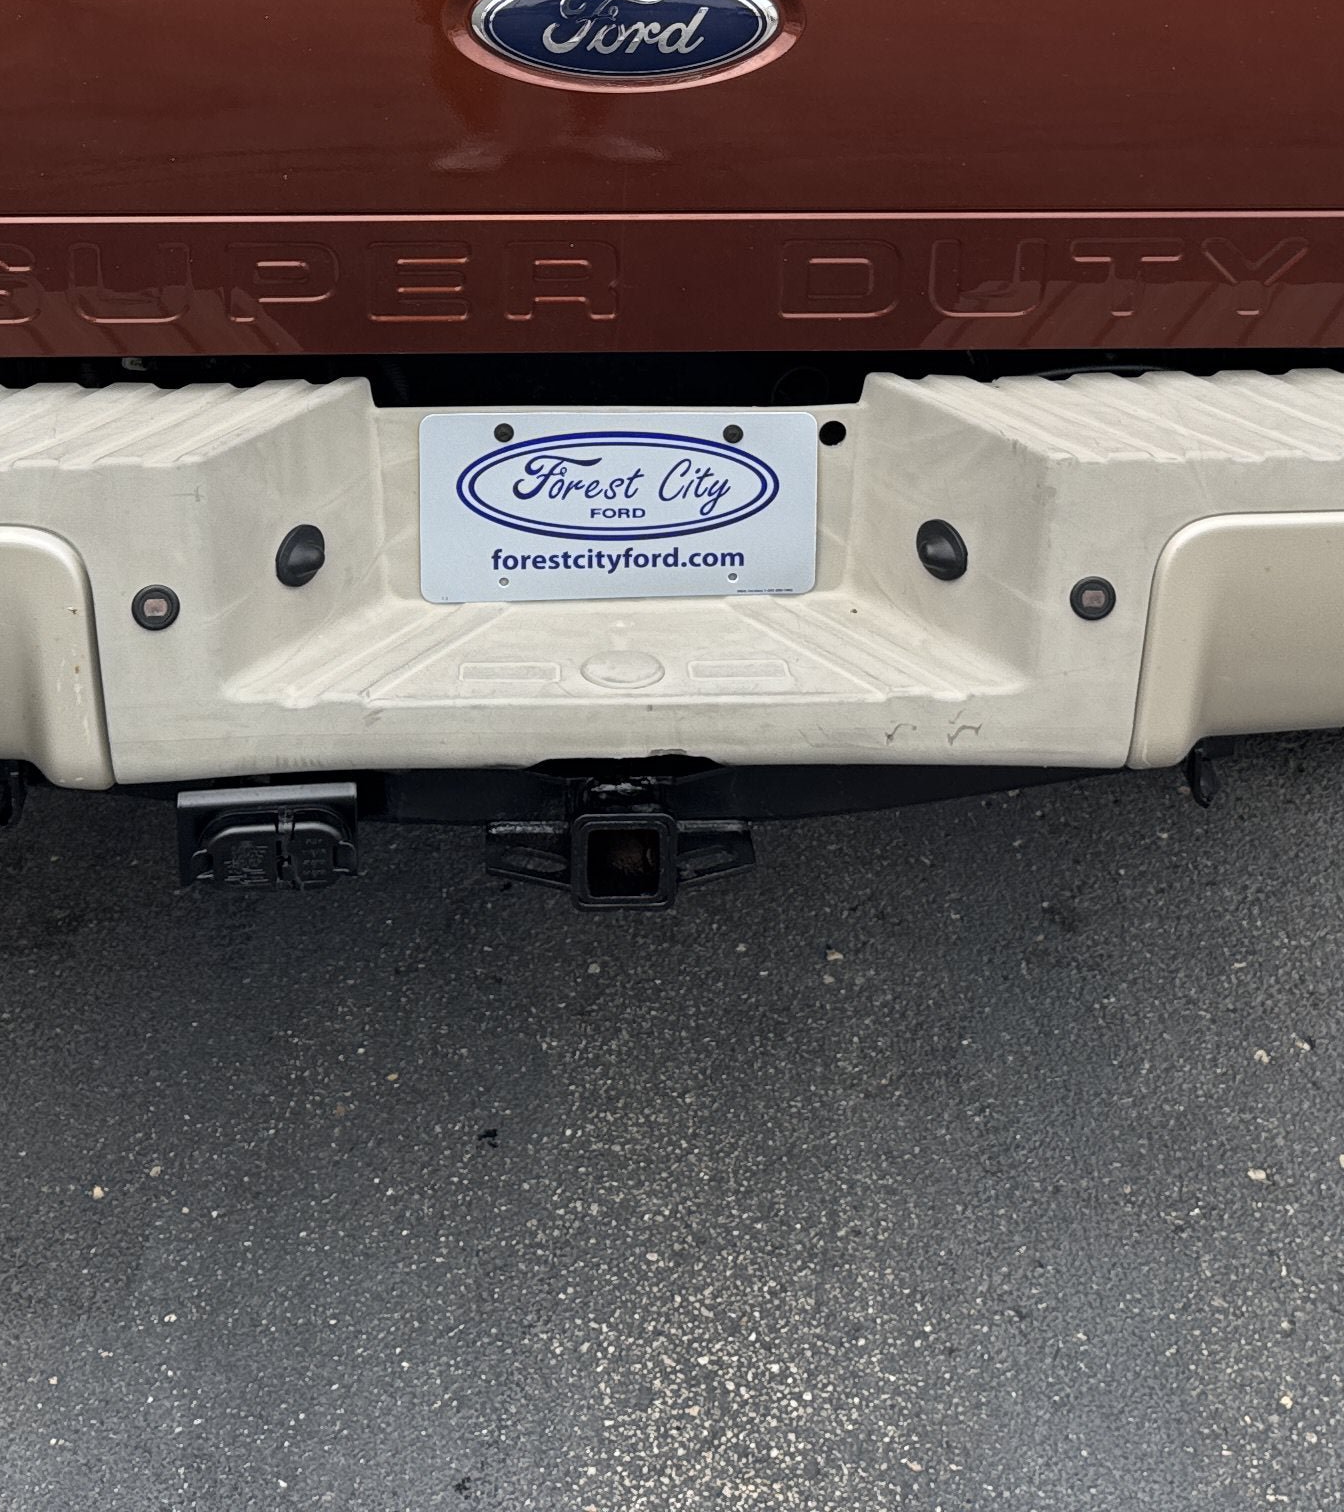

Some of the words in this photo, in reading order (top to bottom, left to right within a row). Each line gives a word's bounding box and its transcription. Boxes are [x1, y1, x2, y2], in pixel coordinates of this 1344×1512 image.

[778, 236, 1309, 320] DUTY
[512, 455, 645, 500] Forest
[659, 459, 731, 516] City
[590, 508, 646, 519] FORD
[491, 547, 745, 574] forestcityford.com
